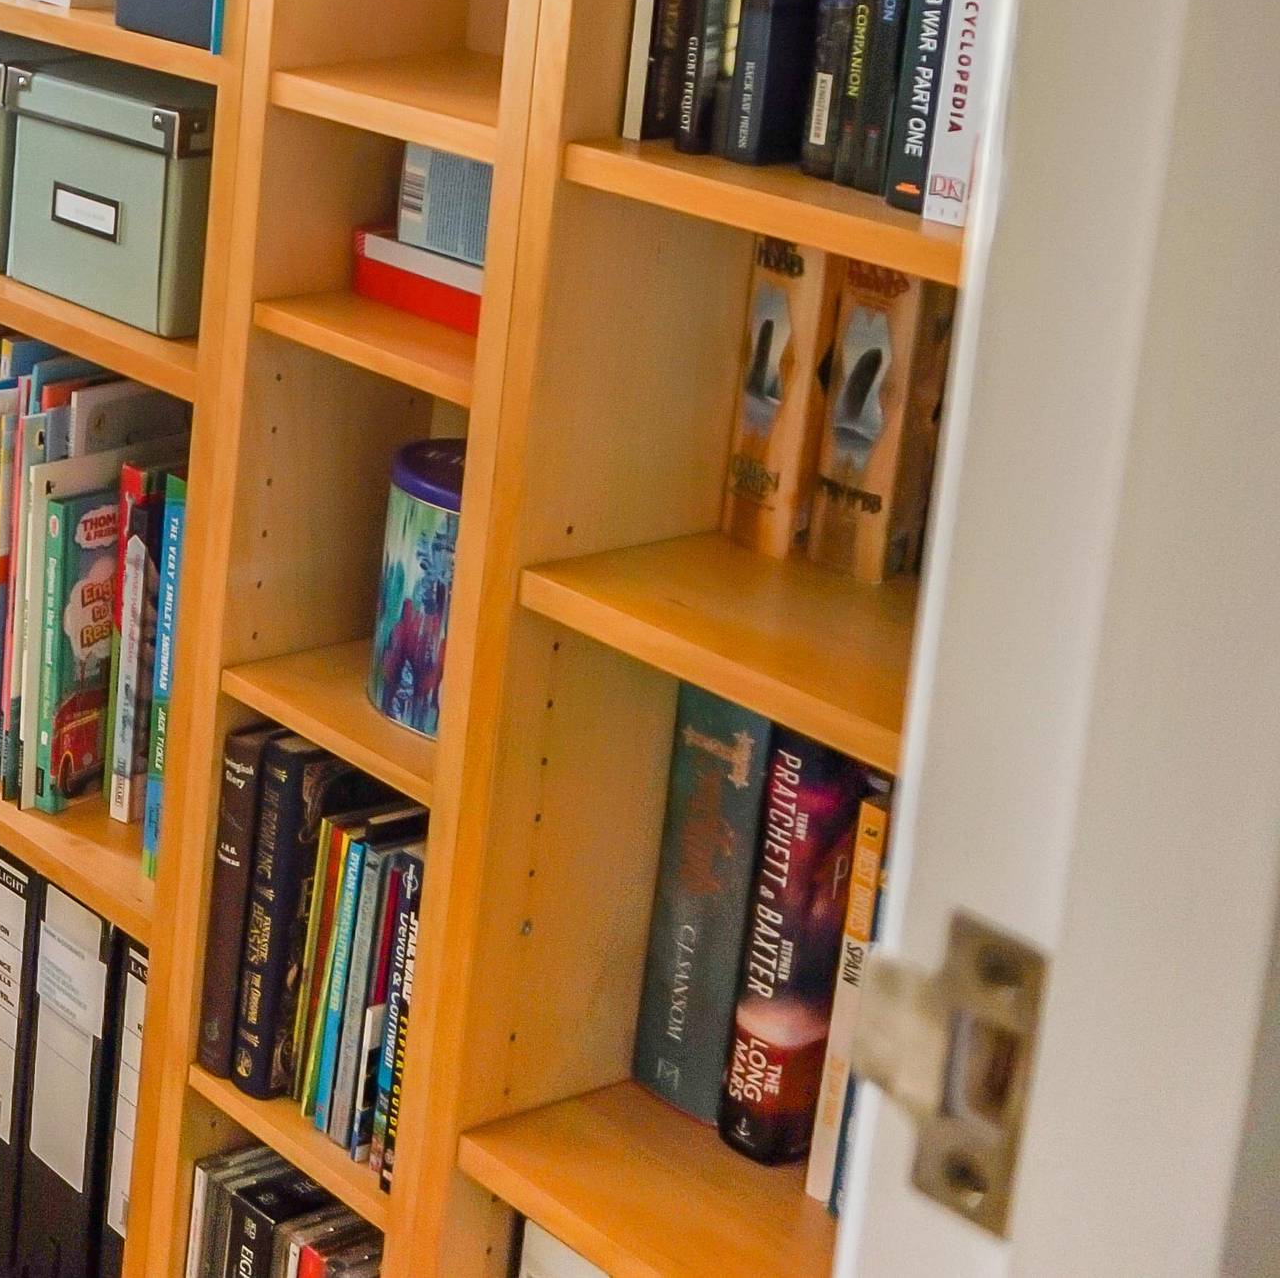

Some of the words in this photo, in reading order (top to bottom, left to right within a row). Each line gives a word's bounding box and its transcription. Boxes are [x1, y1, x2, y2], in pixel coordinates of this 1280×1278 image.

[845, 4, 870, 96] COMPANION
[916, 11, 942, 49] WAR
[908, 66, 936, 111] PART
[902, 117, 929, 155] ONE
[168, 517, 178, 540] THE
[166, 546, 176, 578] VERY
[162, 583, 174, 630] SMILEY
[158, 633, 170, 690] SNOWMAN
[156, 707, 167, 732] JACK
[154, 736, 165, 770] TICKLE
[762, 748, 802, 889] PRATCHETT
[759, 886, 775, 900] &
[392, 913, 411, 966] Devon
[748, 902, 784, 999] BAXTER
[391, 972, 402, 986] &
[843, 941, 863, 988] SPAIN
[380, 992, 403, 1067] Cornwall
[392, 1016, 410, 1080] EXPERT
[728, 1038, 750, 1102] MARS
[743, 1036, 770, 1103] LONG
[763, 1063, 783, 1096] THE
[386, 1084, 402, 1137] GUIDE
